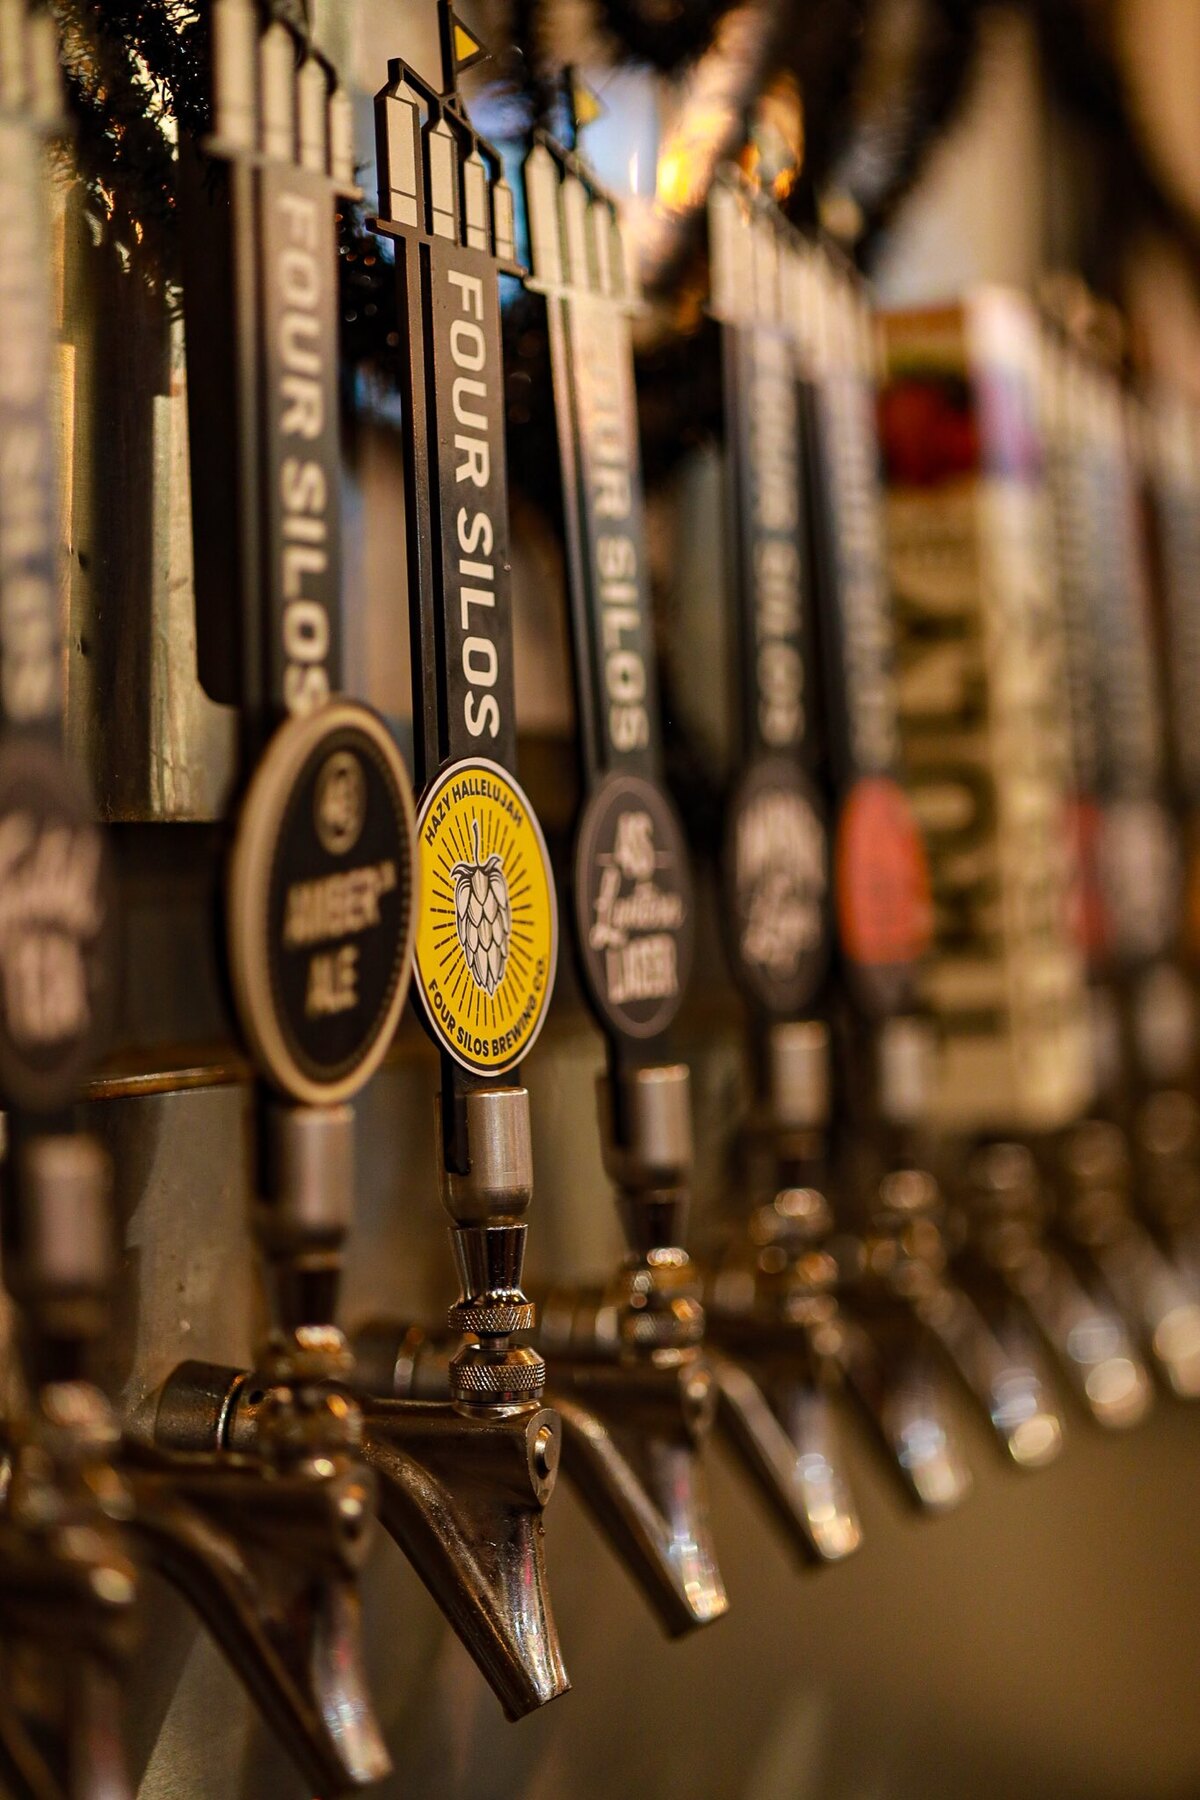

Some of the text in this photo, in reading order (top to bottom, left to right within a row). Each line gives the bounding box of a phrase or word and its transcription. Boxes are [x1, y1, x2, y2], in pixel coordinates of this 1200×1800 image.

[279, 190, 331, 713] FOUR SILOS
[448, 270, 500, 739] FOUR SILOS
[594, 535, 649, 752] SILOS
[425, 792, 451, 846] HAZY
[451, 778, 523, 828] HALLELUJAH
[428, 978, 457, 1035] FOUR
[456, 1026, 489, 1057] SILOS
[491, 994, 537, 1056] BREWING
